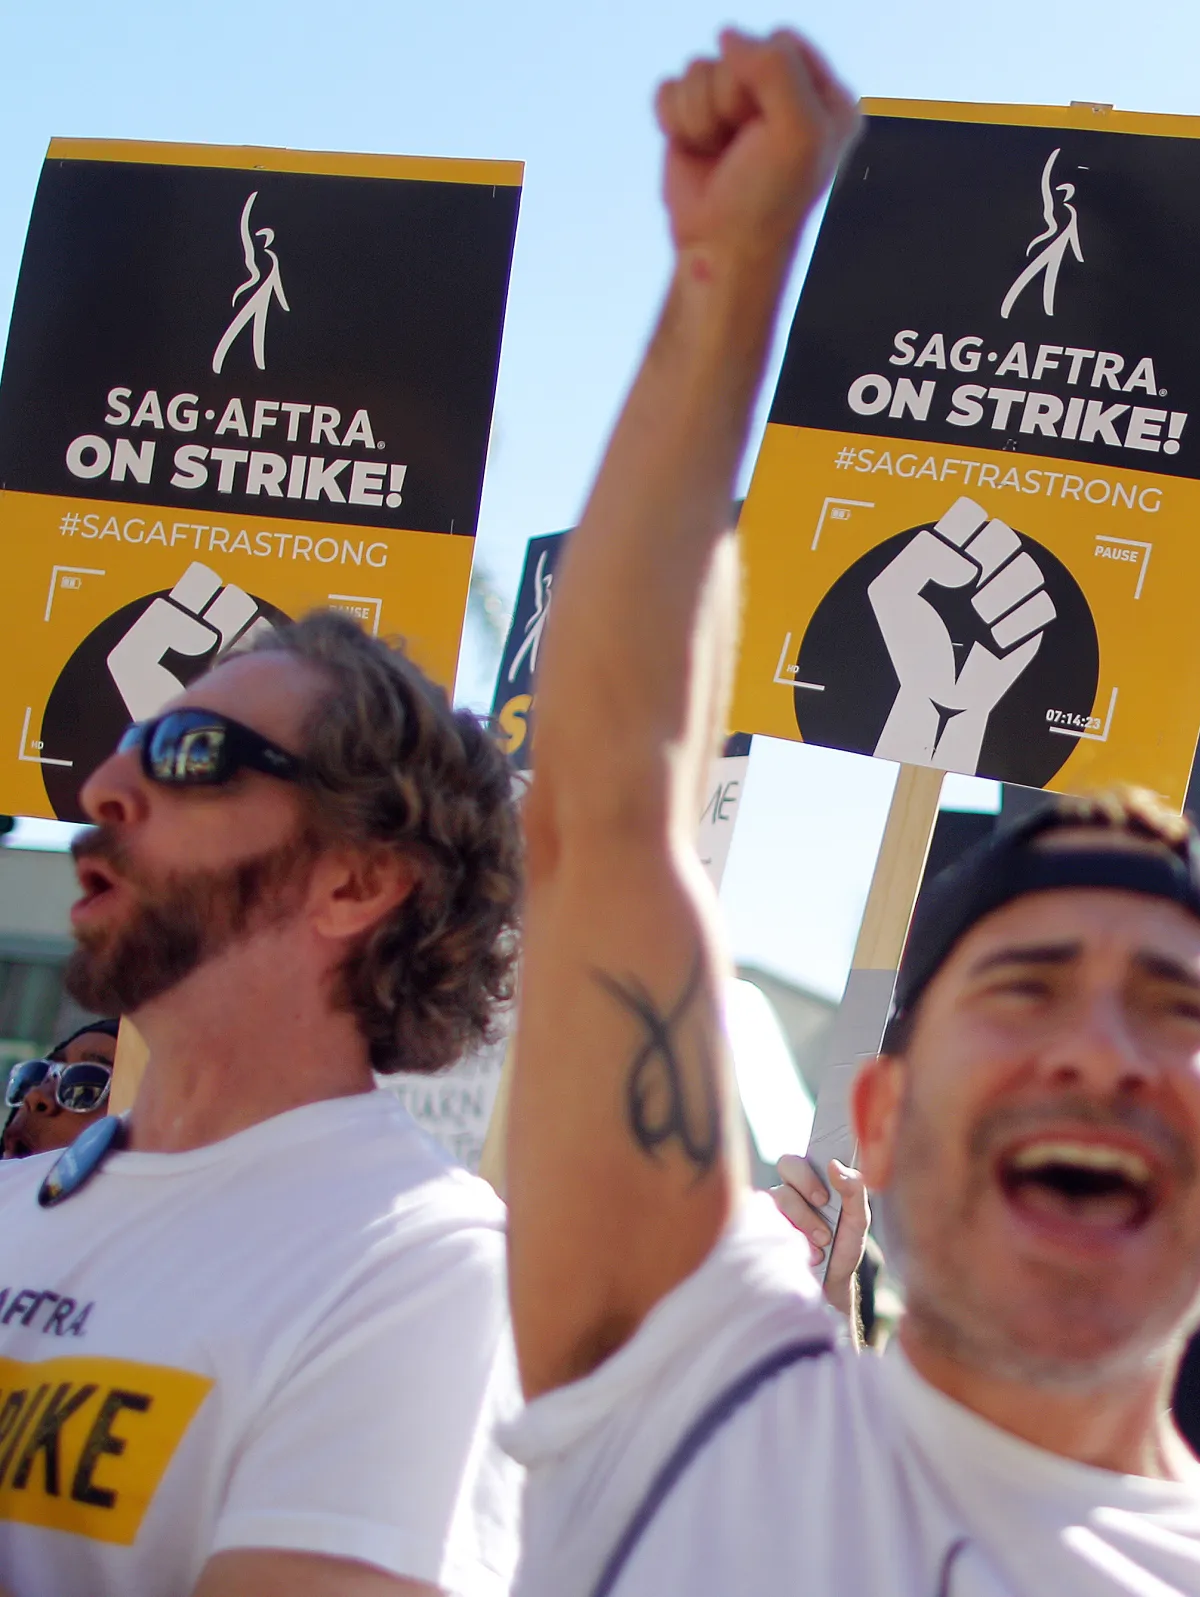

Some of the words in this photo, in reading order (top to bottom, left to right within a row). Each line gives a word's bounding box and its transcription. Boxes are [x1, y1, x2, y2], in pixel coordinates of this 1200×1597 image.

[847, 373, 936, 421] ON
[946, 384, 1188, 455] STRIKE!
[65, 434, 156, 484] ON
[169, 444, 408, 509] STRIKE!
[834, 446, 1163, 513] #SAGAFTRASTRONG
[59, 511, 388, 568] #SAGAFTRASTRONG
[1094, 545, 1138, 562] PAUSE
[1045, 708, 1102, 730] 07:14:23
